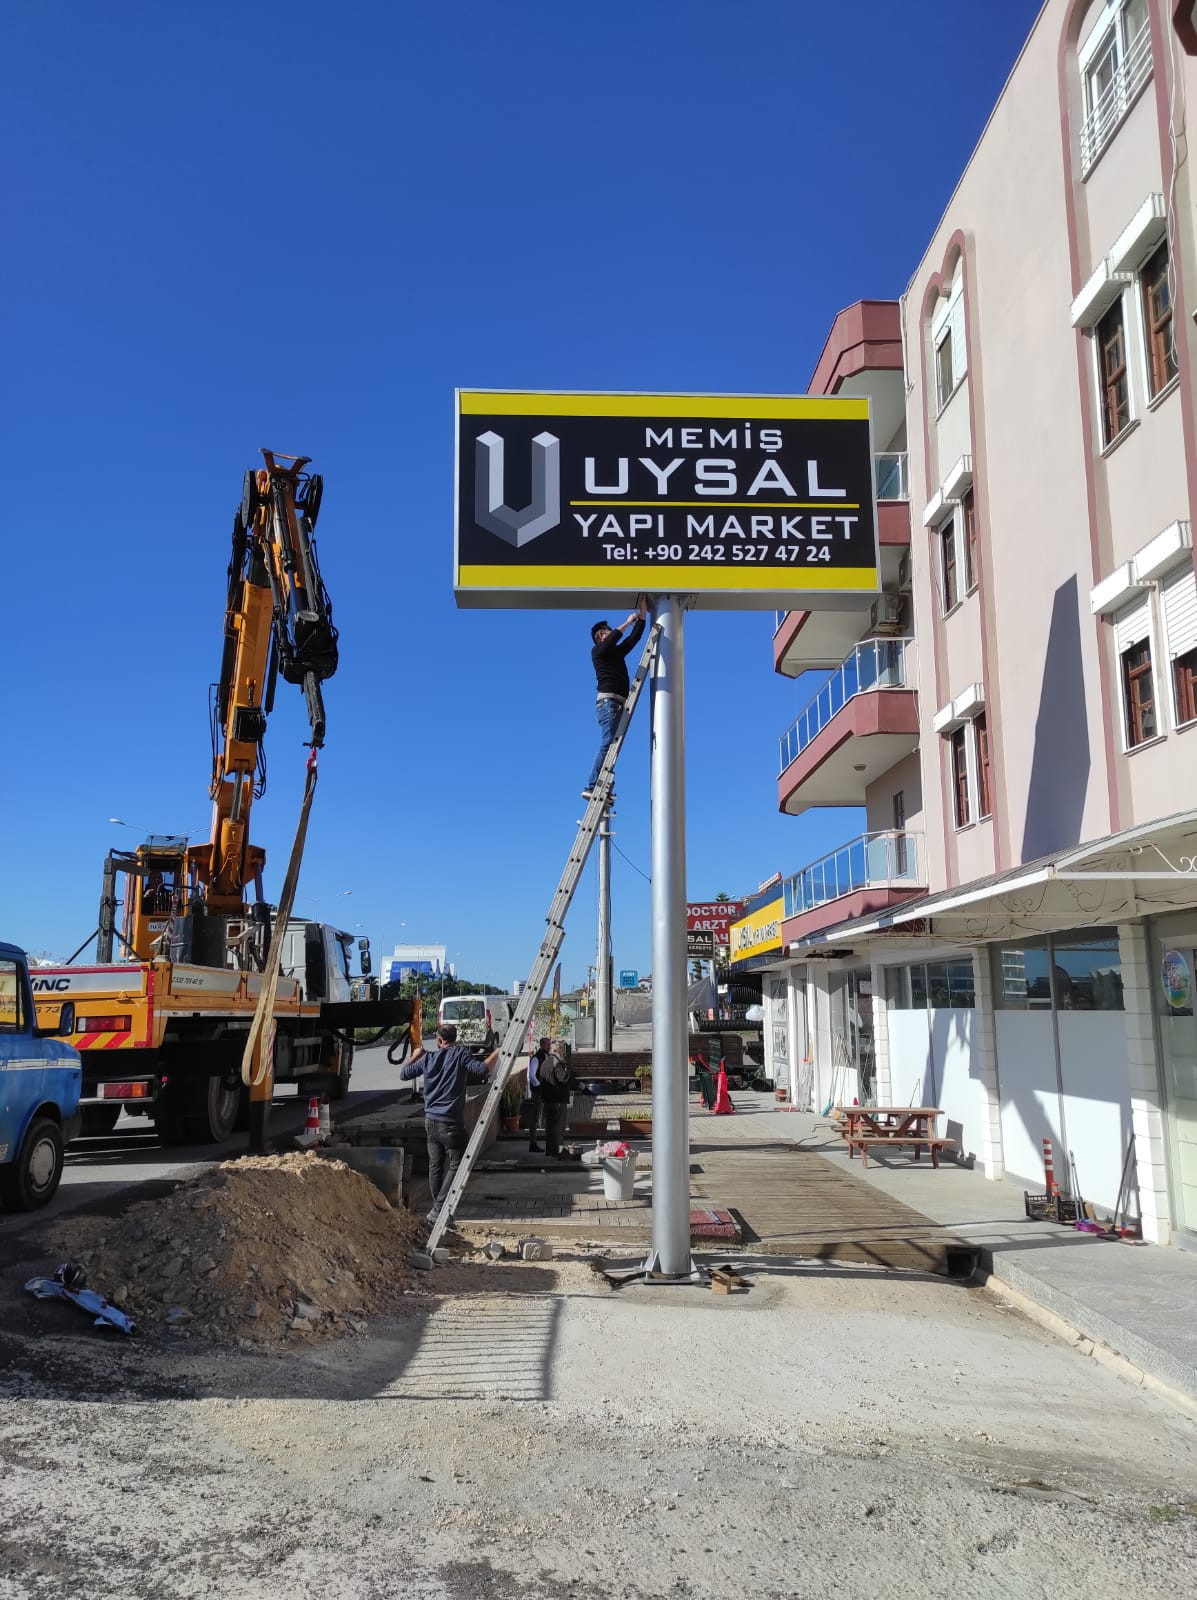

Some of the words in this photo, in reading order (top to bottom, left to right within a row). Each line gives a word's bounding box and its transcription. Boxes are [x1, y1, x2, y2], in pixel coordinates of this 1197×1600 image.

[645, 422, 783, 453] MEMİŞ
[584, 457, 847, 497] UYSAL
[572, 513, 664, 538] YAPI
[687, 514, 859, 540] MARKET
[602, 543, 638, 560] Tel:
[644, 544, 682, 561] +90
[688, 544, 726, 561] 242
[732, 545, 768, 561] 527
[775, 545, 799, 562] 47
[806, 545, 831, 562] 24
[694, 919, 728, 930] ARZT
